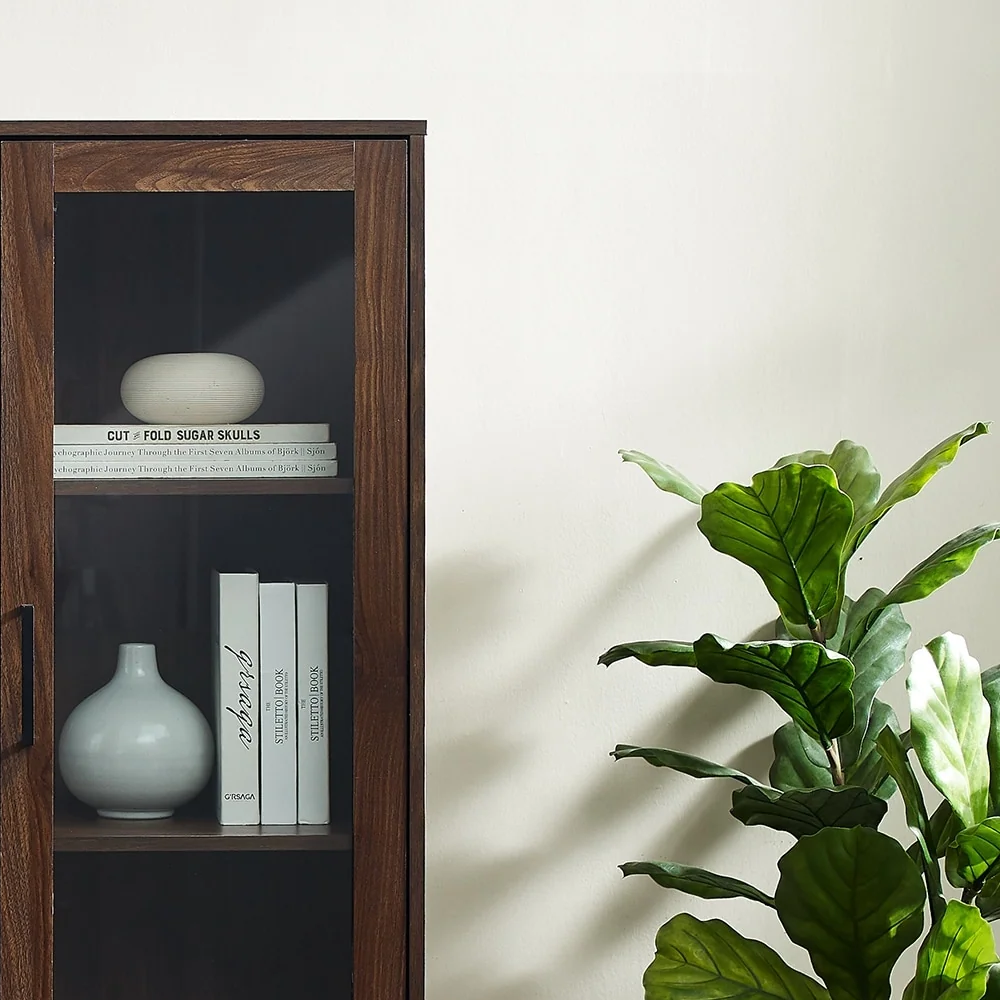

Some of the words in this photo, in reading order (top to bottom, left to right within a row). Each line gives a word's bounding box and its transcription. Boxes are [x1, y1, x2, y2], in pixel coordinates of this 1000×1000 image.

[107, 430, 130, 441] CUT
[143, 430, 172, 441] FOLD
[176, 430, 214, 441] SUGAR
[217, 429, 261, 440] SKULLS
[103, 448, 135, 458] Journey
[136, 448, 173, 457] Through
[173, 448, 187, 456] the
[188, 448, 208, 456] First
[209, 447, 233, 456] Seven
[235, 447, 266, 456] Albums
[267, 447, 276, 455] of
[277, 447, 299, 457] Björk
[306, 447, 326, 457] Sjón
[103, 465, 136, 475] Journey
[137, 465, 173, 474] Through
[174, 465, 188, 473] the
[209, 464, 234, 472] Seven
[235, 464, 267, 472] Albums
[267, 464, 277, 472] of
[278, 464, 300, 474] Björk
[307, 464, 326, 474] Sjón
[274, 668, 285, 695] BOOK
[309, 665, 320, 692] BOOK
[274, 697, 285, 745] STILETTO
[309, 695, 320, 742] STILETTO
